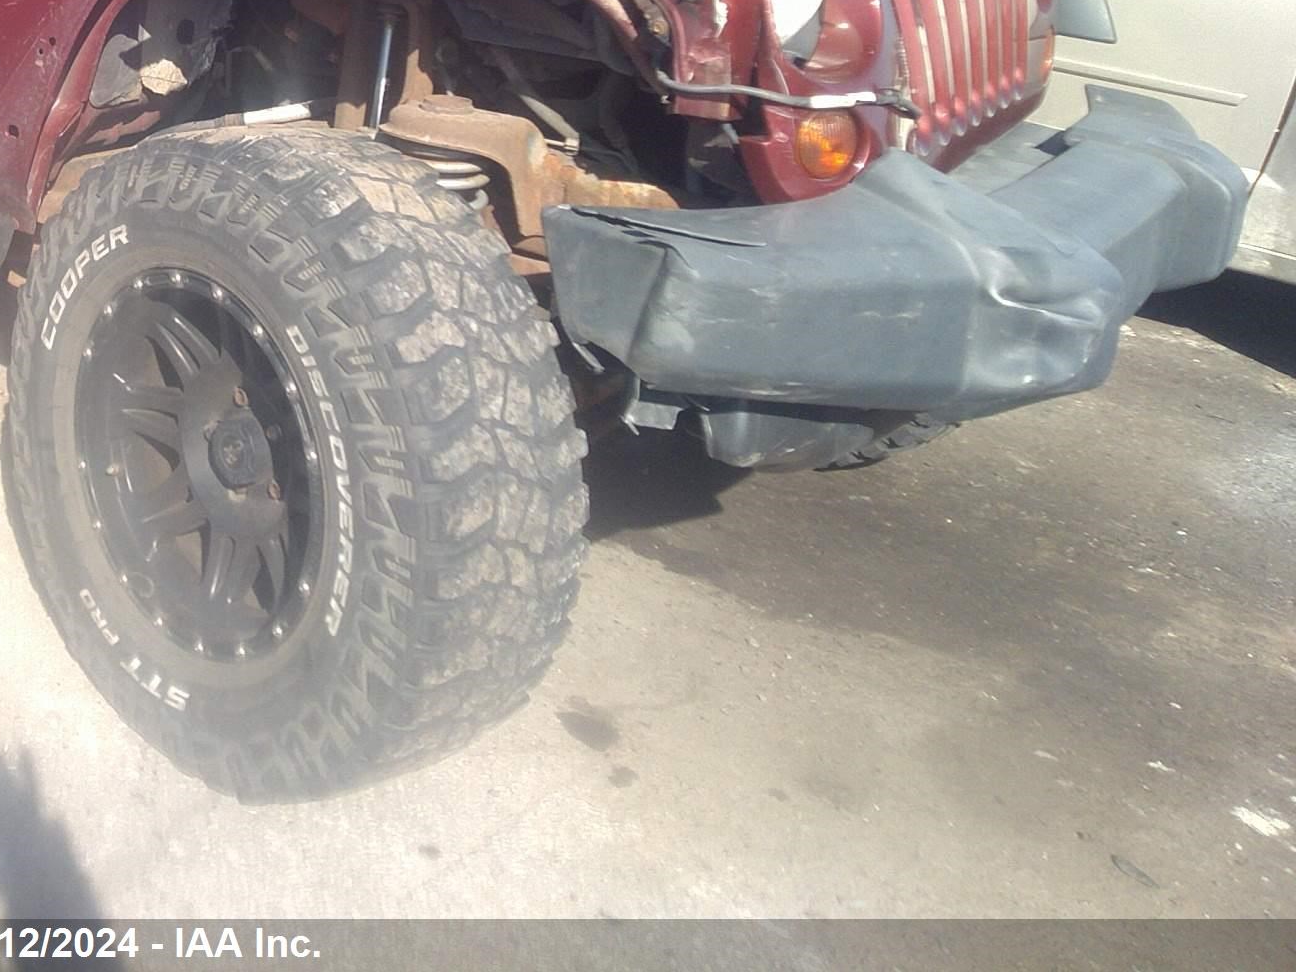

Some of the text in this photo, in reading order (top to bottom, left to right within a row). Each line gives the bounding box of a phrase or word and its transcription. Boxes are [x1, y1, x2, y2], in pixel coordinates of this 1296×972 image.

[41, 223, 131, 350] COOPER
[286, 326, 355, 638] DISCOVERER
[79, 587, 192, 712] STT PRO
